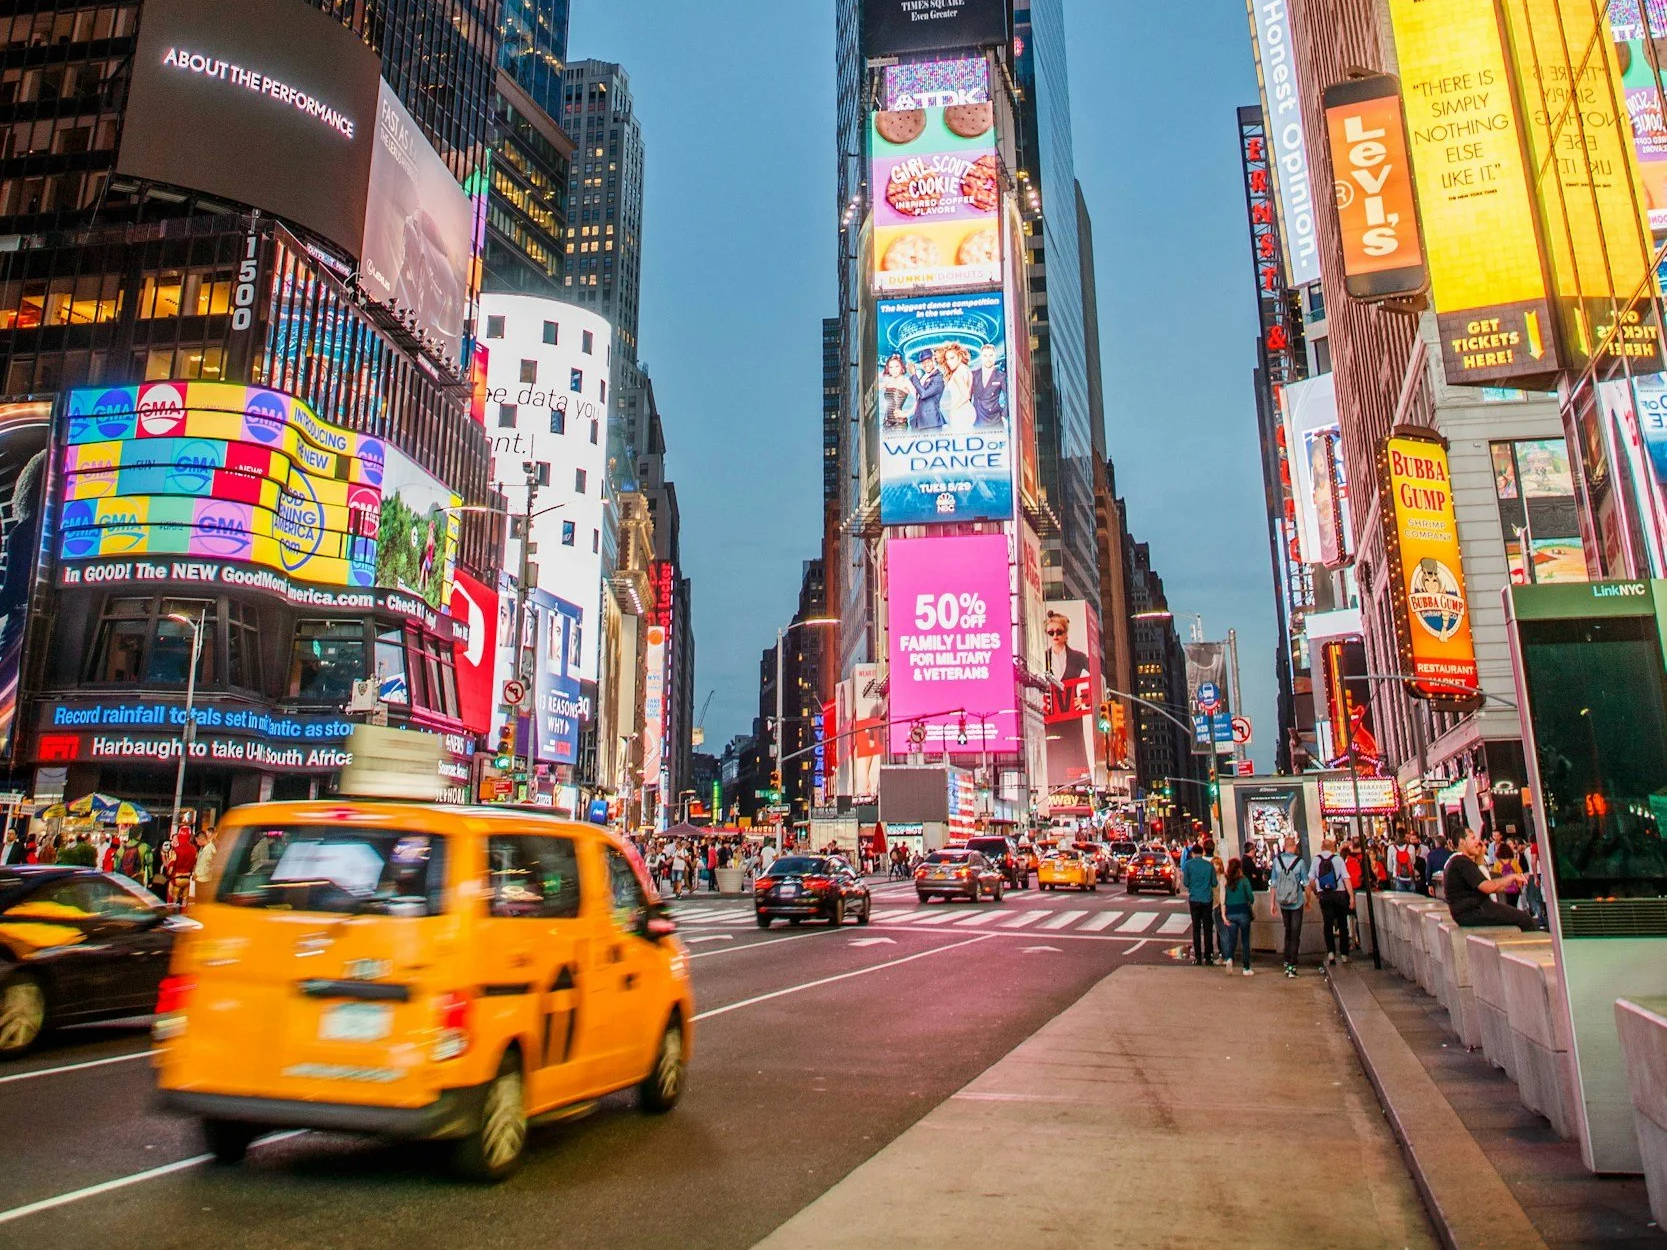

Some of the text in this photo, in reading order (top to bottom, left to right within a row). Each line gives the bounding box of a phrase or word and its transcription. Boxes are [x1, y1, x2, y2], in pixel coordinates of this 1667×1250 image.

[900, 0, 930, 12] TIMES
[911, 10, 958, 22] Even Greater
[1478, 69, 1494, 86] IS
[163, 48, 354, 139] ABOUT THE PERFORMANCE
[1431, 92, 1489, 118] SIMPLY
[382, 99, 409, 150] FAST AS
[1262, 0, 1294, 115] Honest
[1282, 123, 1316, 268] Opinion.
[1414, 113, 1509, 145] NOTHING
[1446, 142, 1484, 164] ELSE
[891, 155, 977, 185] GIRL SCOUT
[1441, 168, 1474, 189] LIKE
[909, 176, 959, 199] COOKIE
[895, 195, 975, 210] INSPIRED COFFEE
[914, 205, 957, 216] FLAVORS
[1247, 138, 1288, 349] ERNST &
[231, 235, 258, 330] 1500
[372, 269, 391, 292] LEXUS
[937, 269, 984, 281] DONUTS
[880, 297, 1000, 314] The biggest dance competition
[915, 307, 965, 318] in the world.
[1467, 318, 1500, 335] GET
[1452, 331, 1520, 353] TICKETS
[1463, 349, 1513, 369] HERE!
[141, 400, 181, 417] GMA
[518, 382, 569, 412] data
[576, 400, 600, 420] you
[93, 403, 135, 422] GMA
[246, 405, 285, 430] GMA
[294, 407, 347, 451] INTRODUCING
[883, 437, 1007, 456] WORLD OF
[174, 456, 217, 474] GMA
[303, 451, 329, 470] NEW
[910, 453, 1002, 471] DANCE
[1391, 450, 1447, 482] BUBBA
[280, 486, 305, 507] OOD
[919, 482, 972, 494] TUES 5/29
[1400, 483, 1446, 512] GUMP
[936, 504, 955, 514] NBC
[62, 516, 99, 537] GMA
[100, 513, 142, 533] GMA
[198, 516, 247, 537] GMA
[273, 517, 315, 541] AMERICA
[1408, 518, 1446, 529] SHRIMP
[1404, 529, 1452, 541] COMPANY
[64, 567, 81, 583] in
[84, 563, 131, 581] GOOD!
[135, 562, 168, 579] The
[171, 562, 219, 581] NEW
[386, 594, 417, 615] Check
[658, 562, 671, 608] Locker
[1593, 583, 1646, 597] LinkNYC
[914, 592, 986, 631] 50%
[1410, 595, 1464, 613] BUBBA GUMP
[960, 614, 986, 629] OFF
[900, 633, 1002, 652] FAMILY LINES
[909, 651, 992, 667] FOR MILITARY
[1417, 663, 1474, 675] RESTAURANT
[913, 666, 990, 682] & VETERANS
[1429, 676, 1467, 688] MARKET
[548, 696, 579, 719] REASONS
[54, 704, 322, 737] Record rainfall totals set in as
[548, 716, 565, 734] WHY
[92, 737, 183, 758] Harbaugh
[188, 741, 207, 757] to
[211, 740, 245, 759] take
[265, 746, 303, 766] South
